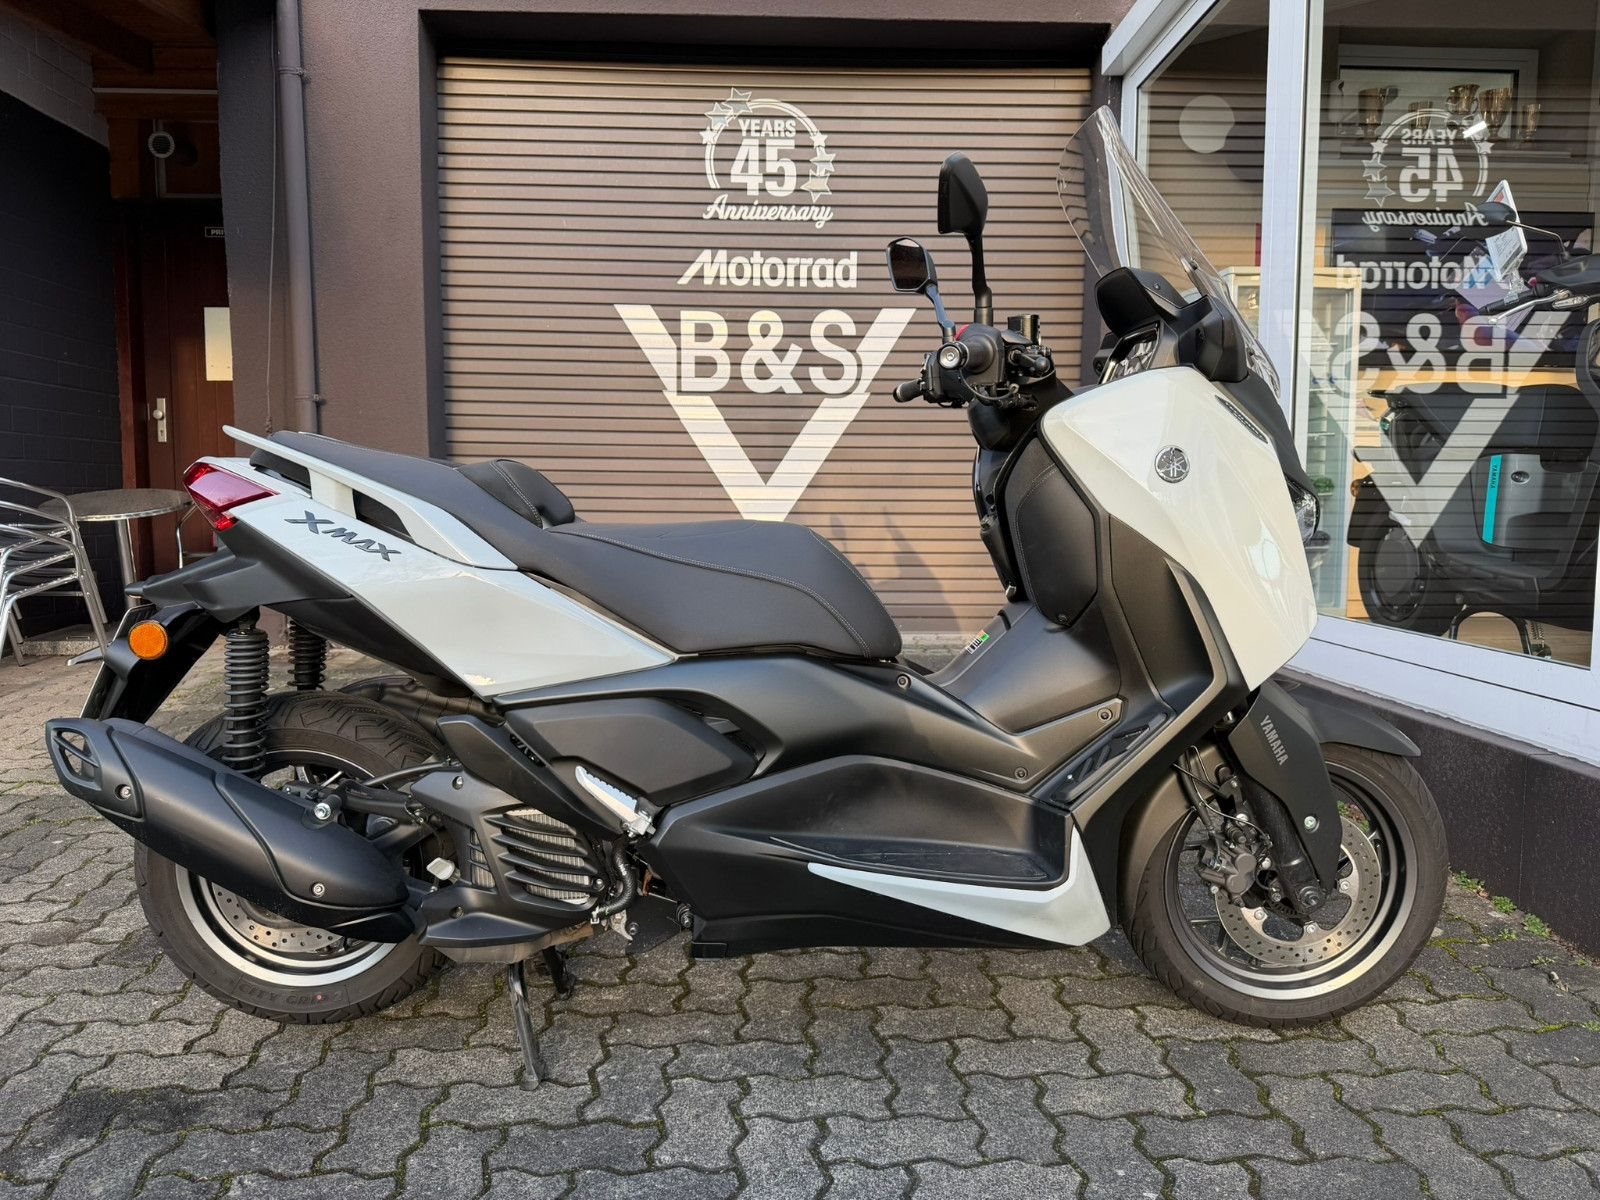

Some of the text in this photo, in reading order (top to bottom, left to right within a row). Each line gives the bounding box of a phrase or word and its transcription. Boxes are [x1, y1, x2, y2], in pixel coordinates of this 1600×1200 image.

[738, 119, 797, 137] YEARS
[730, 138, 797, 197] 45
[702, 193, 834, 229] Anniversary
[676, 249, 858, 288] Motorrad
[680, 309, 858, 394] B&S
[1260, 714, 1289, 766] YAMAHA
